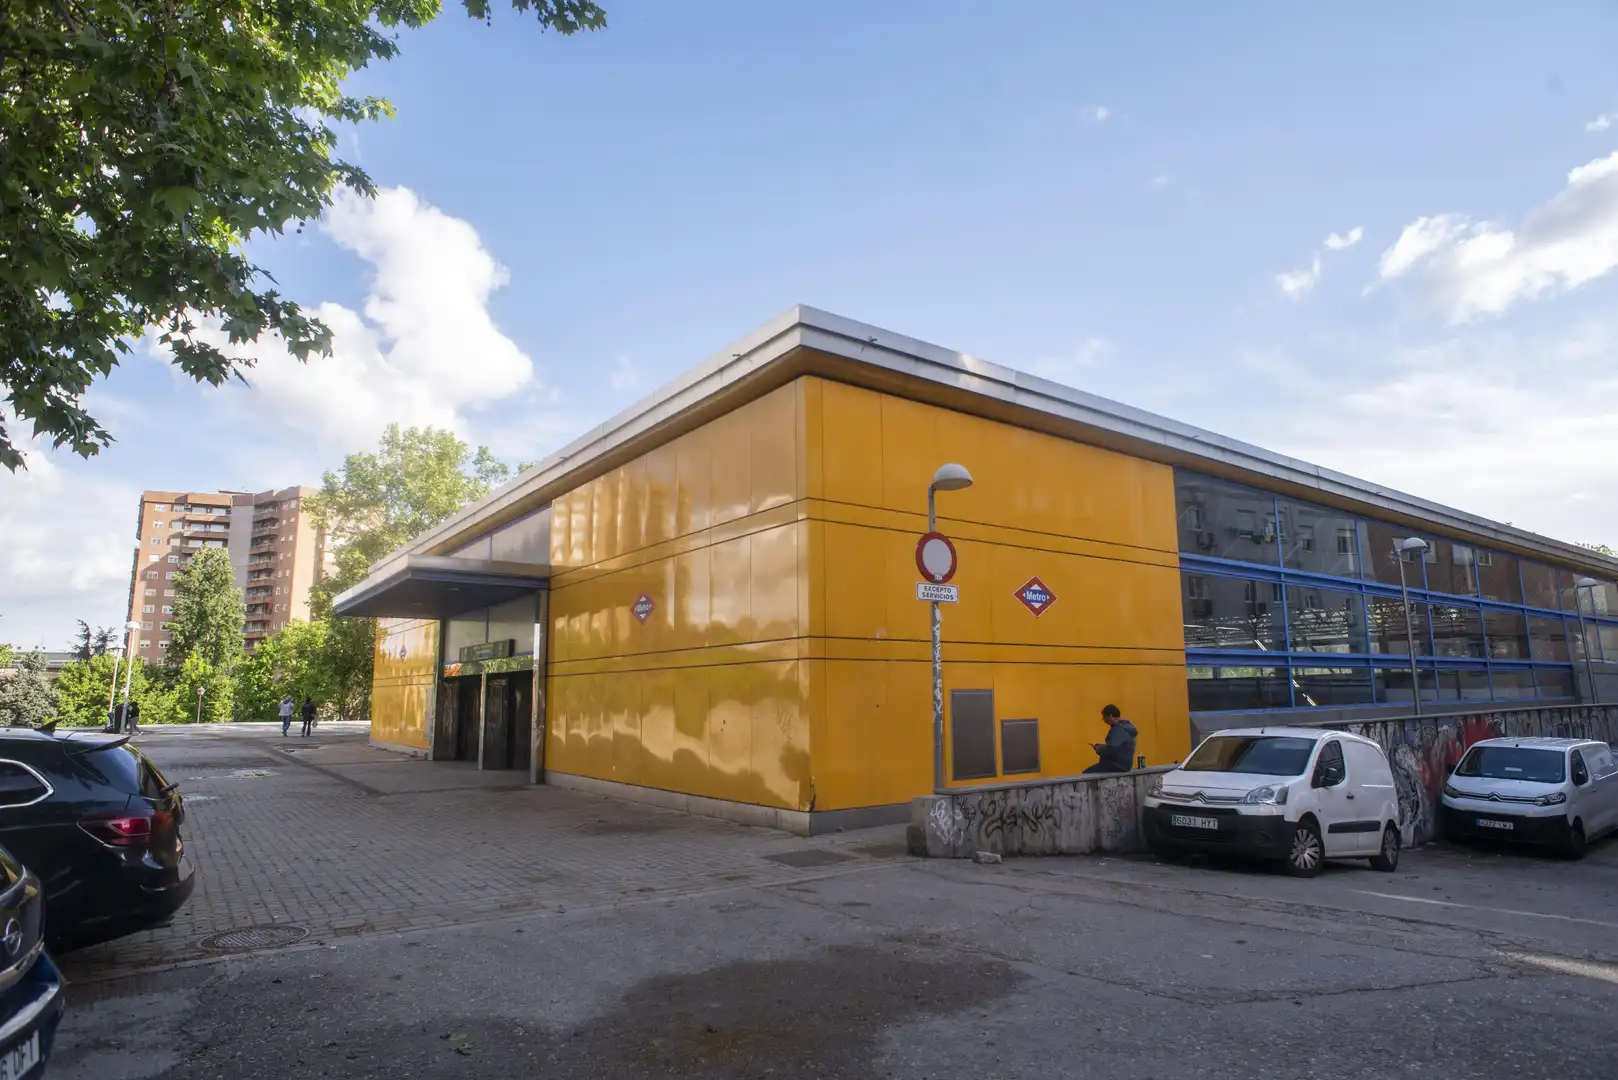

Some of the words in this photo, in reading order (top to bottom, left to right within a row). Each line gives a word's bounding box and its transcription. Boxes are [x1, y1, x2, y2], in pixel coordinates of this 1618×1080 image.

[923, 586, 952, 594] EXCEPTO
[921, 592, 955, 600] SERVICIOS
[1026, 590, 1046, 602] Metro
